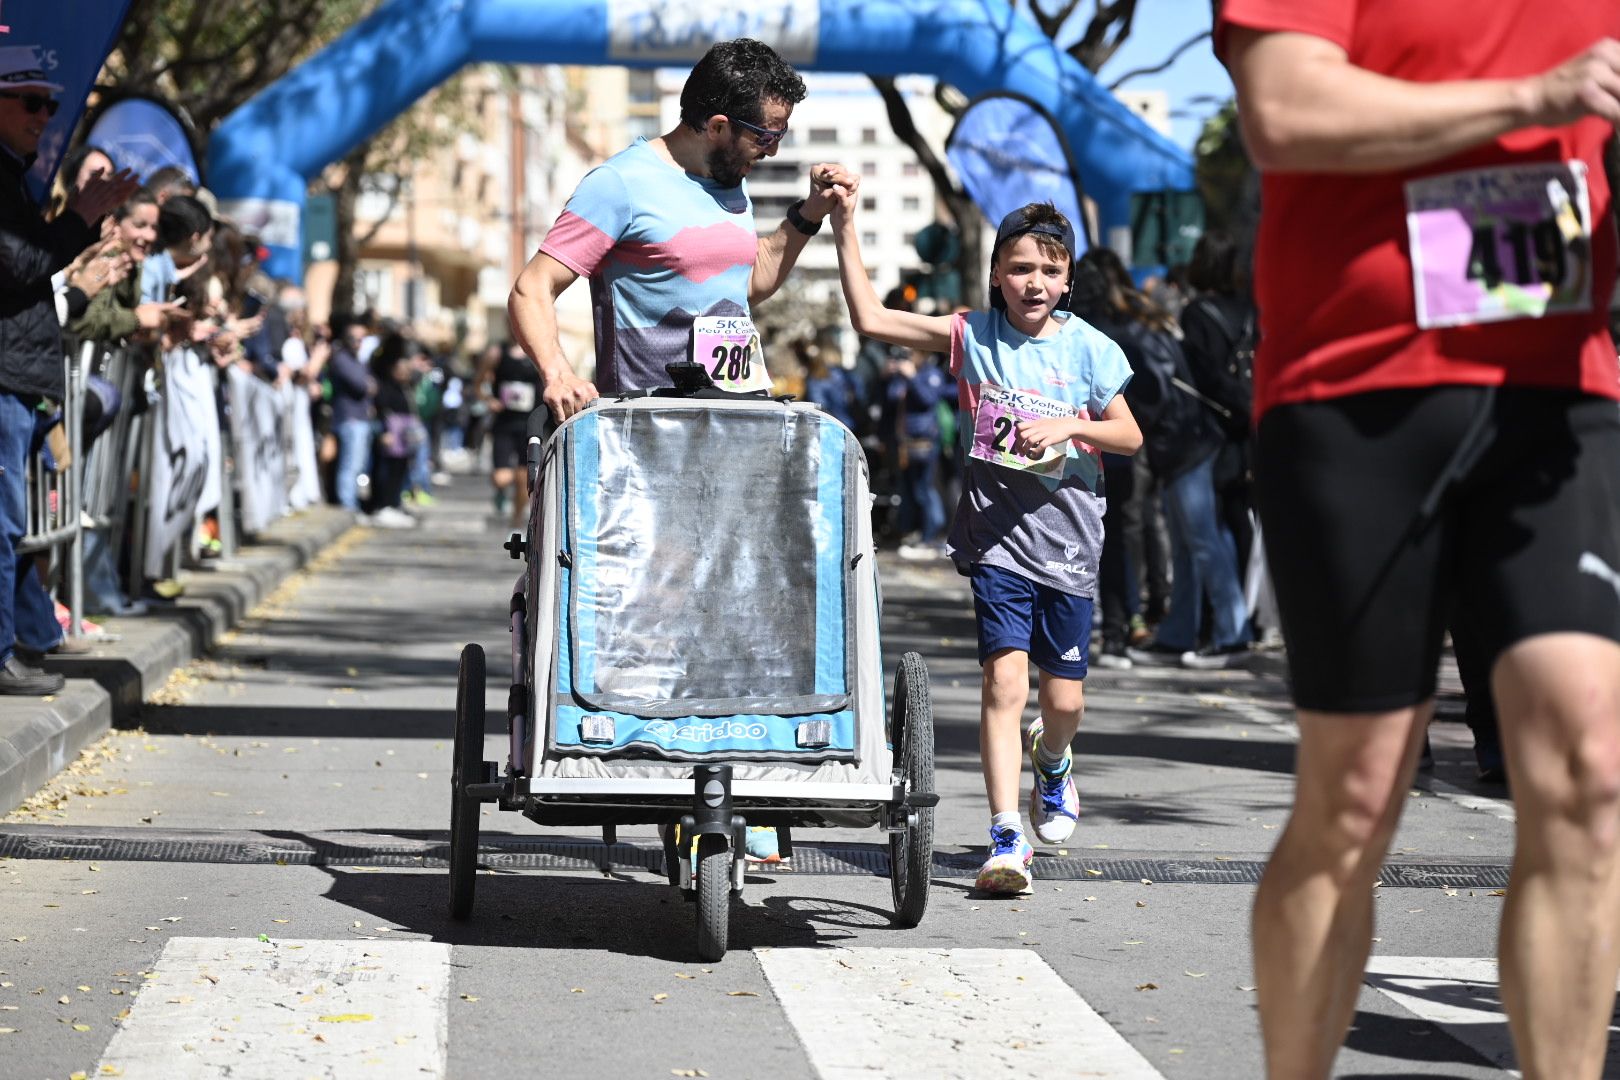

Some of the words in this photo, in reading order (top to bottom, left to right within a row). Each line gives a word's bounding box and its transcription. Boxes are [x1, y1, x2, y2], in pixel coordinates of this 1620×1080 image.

[716, 320, 737, 329] 5K
[711, 345, 751, 381] 280
[999, 391, 1025, 404] 5K
